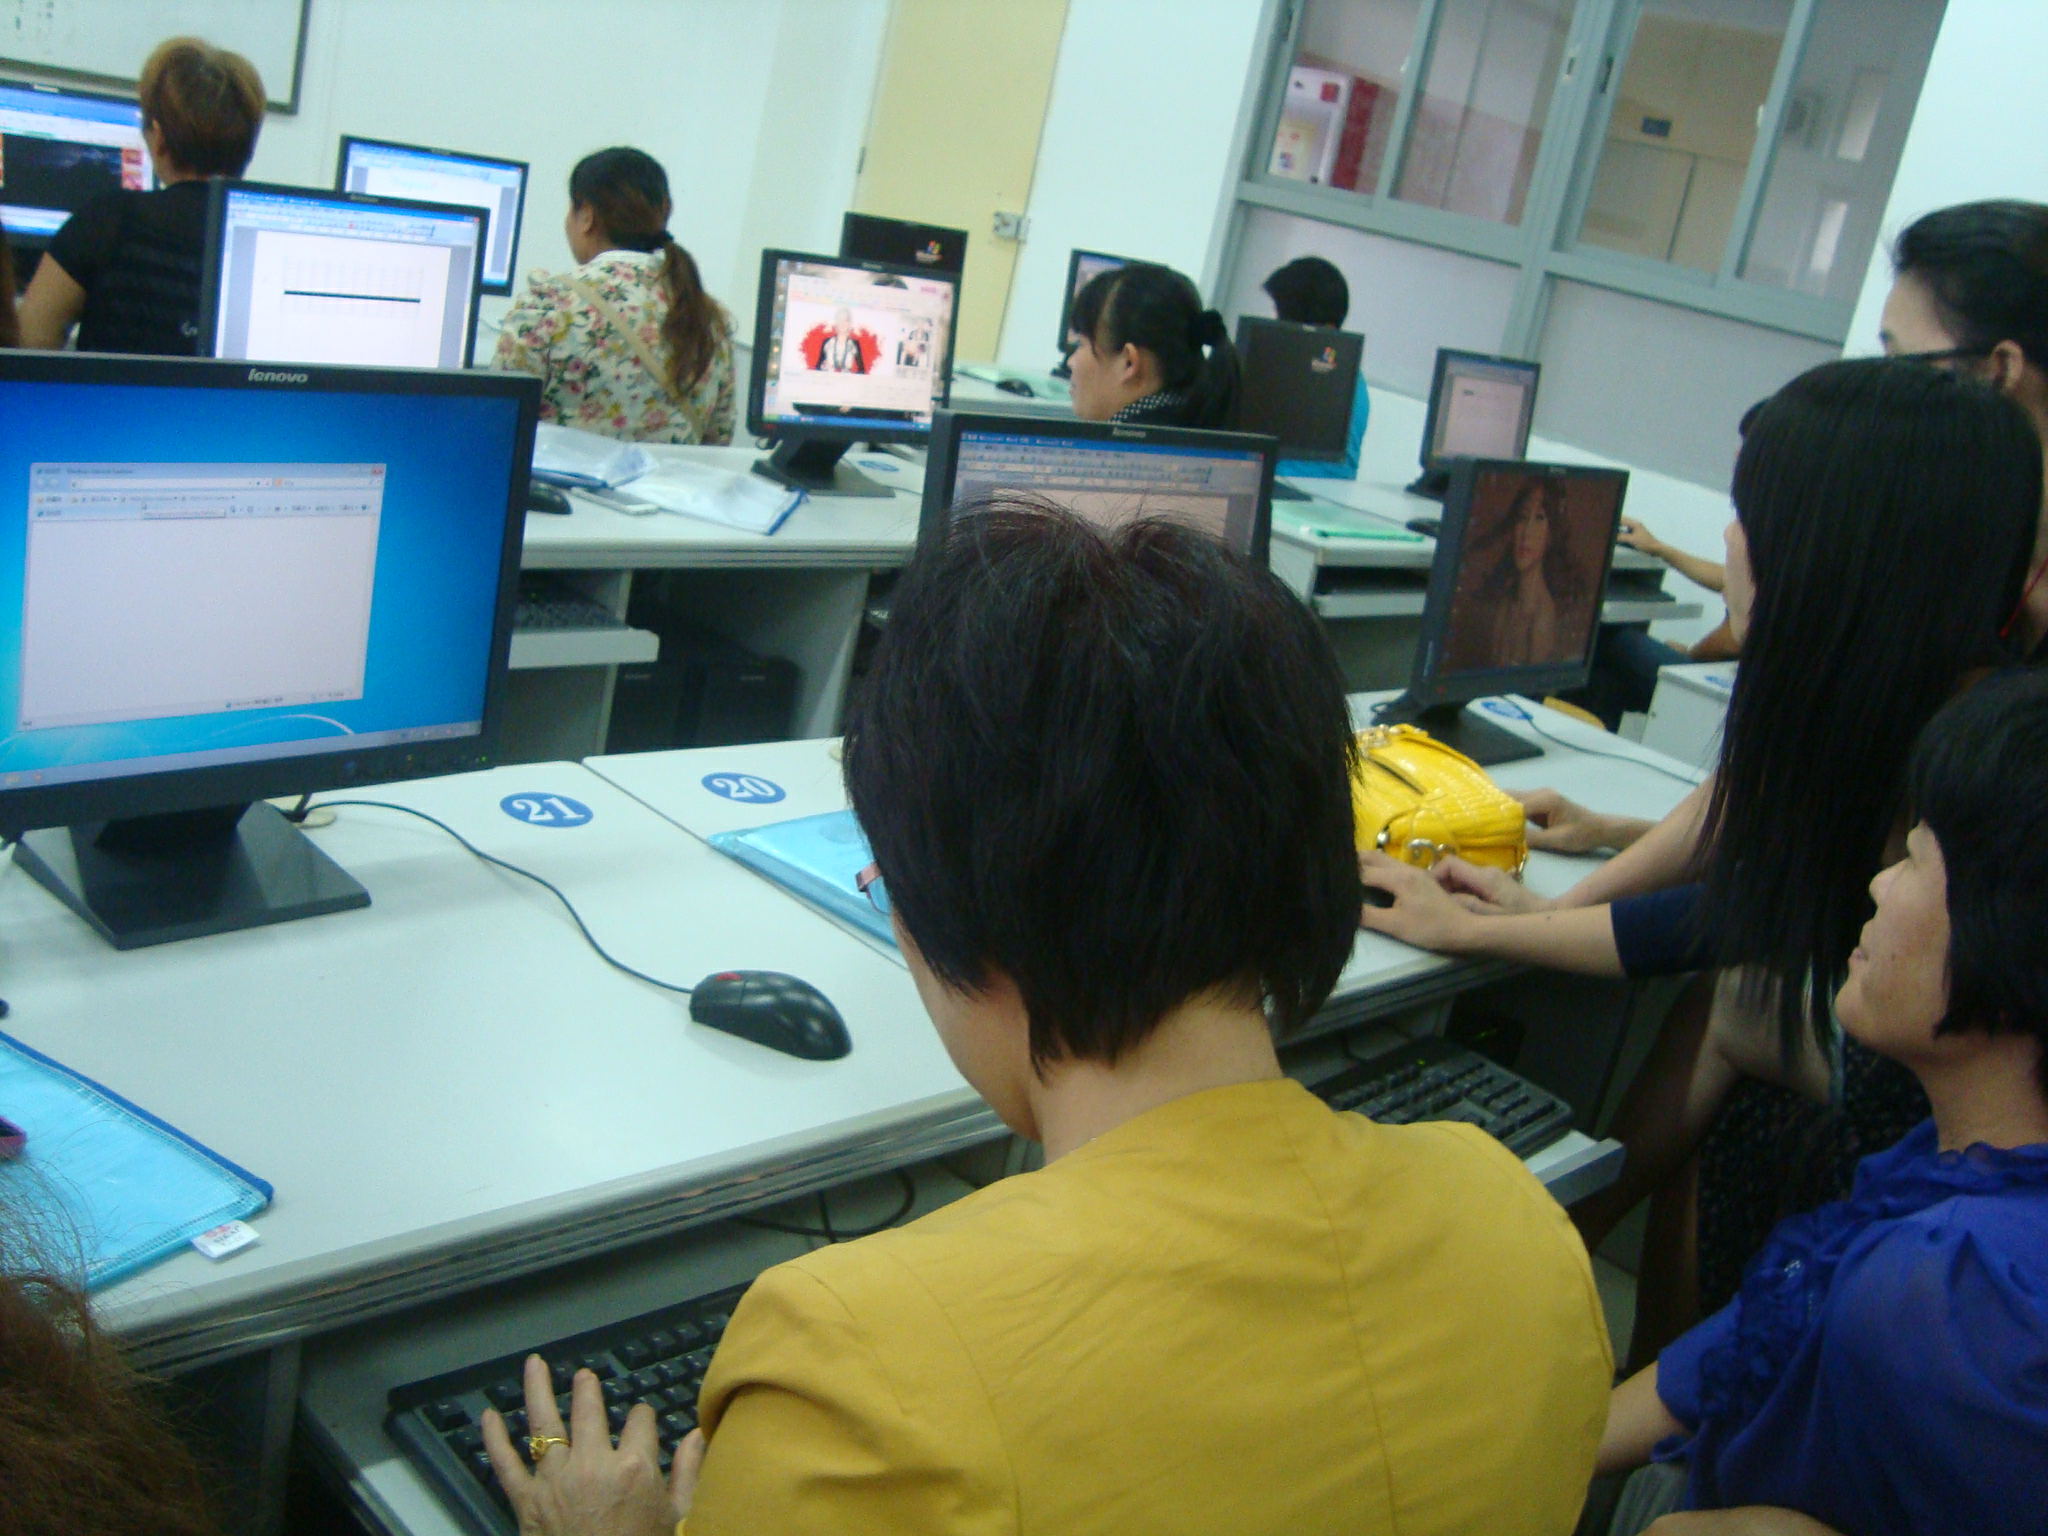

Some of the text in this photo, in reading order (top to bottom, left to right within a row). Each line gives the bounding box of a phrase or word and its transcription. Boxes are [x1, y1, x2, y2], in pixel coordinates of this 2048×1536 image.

[248, 368, 309, 383] lenovo
[712, 777, 777, 799] 20
[511, 796, 585, 822] 21
